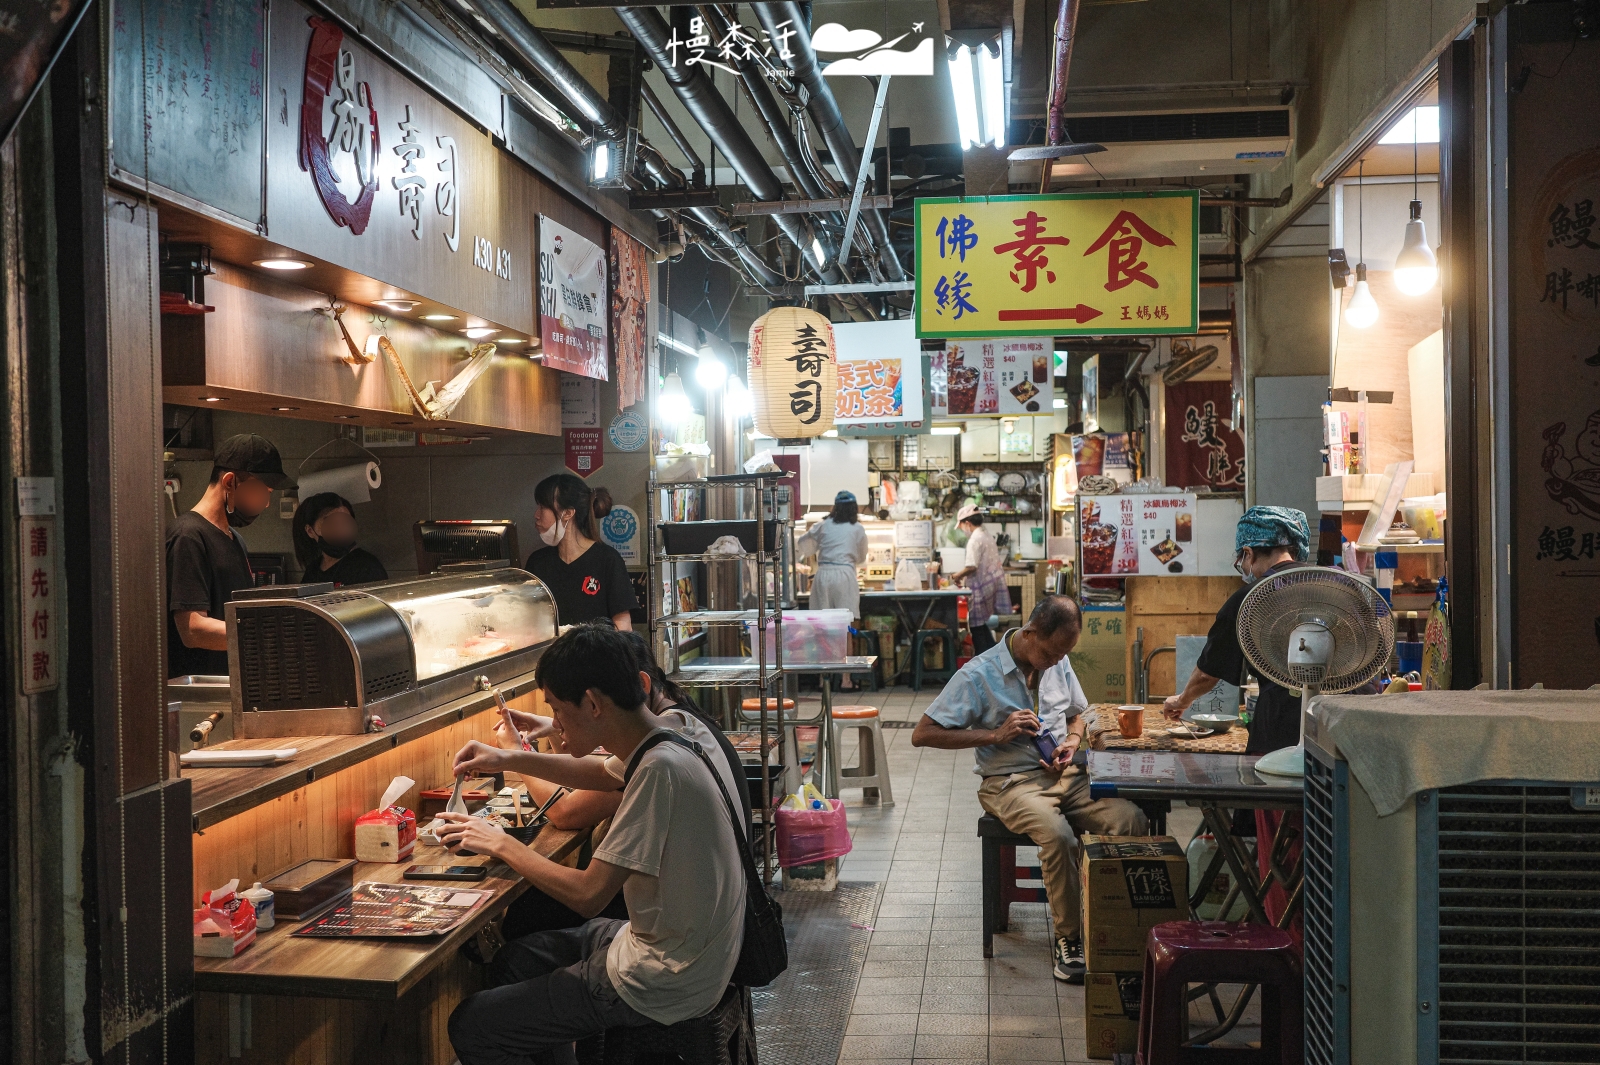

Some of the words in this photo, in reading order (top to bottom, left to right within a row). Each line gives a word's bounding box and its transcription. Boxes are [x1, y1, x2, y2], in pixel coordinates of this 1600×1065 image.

[473, 234, 493, 273] A30
[495, 246, 512, 281] A31
[540, 251, 554, 285] SU
[933, 213, 980, 321] 佛緣
[993, 209, 1177, 293] 素食
[540, 284, 557, 319] SHI
[1119, 305, 1170, 321] 王媽媽
[784, 321, 830, 425] 壽司
[982, 343, 995, 396] 精選紅茶
[1003, 355, 1016, 363] $40
[836, 388, 895, 417] 奶茶
[569, 431, 599, 439] foodomo
[1120, 499, 1134, 554] 精選紅茶
[1143, 511, 1157, 520] $40
[1118, 558, 1137, 569] 30
[30, 526, 50, 682] 請先付款
[1106, 673, 1126, 686] 850
